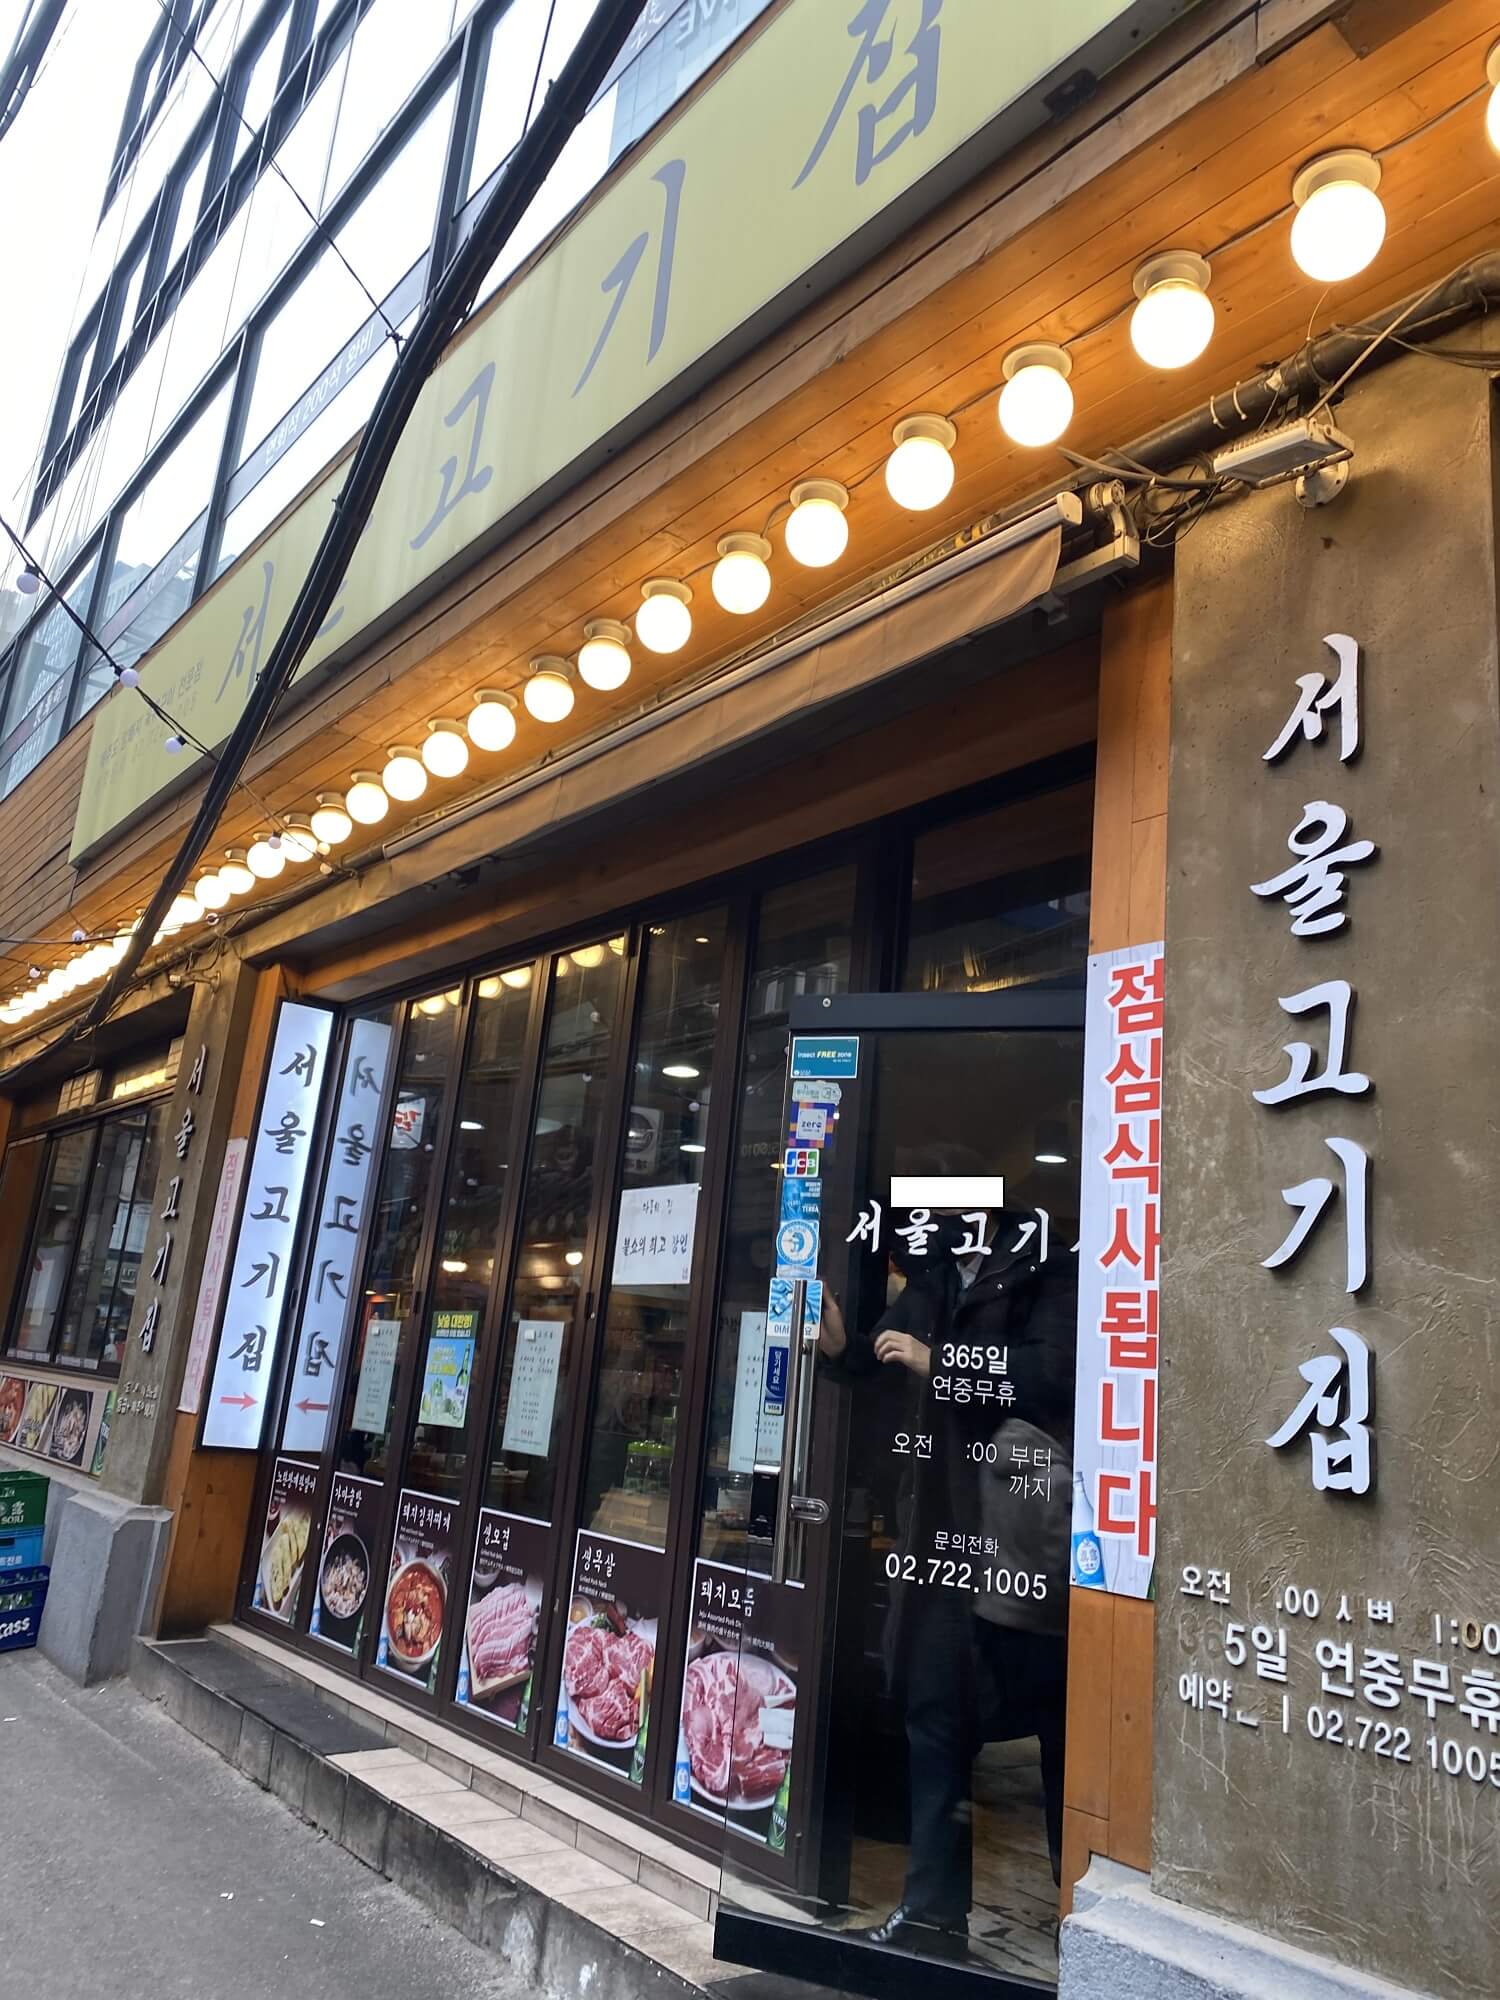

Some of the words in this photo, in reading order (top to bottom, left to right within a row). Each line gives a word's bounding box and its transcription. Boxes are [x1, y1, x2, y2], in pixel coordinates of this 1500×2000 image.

[816, 1050, 837, 1058] FREE
[1249, 633, 1379, 1495] 서울고기집
[785, 1157, 817, 1169] JCB
[138, 1044, 206, 1355] 서울고기집
[228, 1044, 317, 1373] 서울고기집
[846, 1199, 1080, 1263] 서울고기
[1099, 957, 1164, 1557] 점심식사됩니다
[941, 1343, 1009, 1375] 365일
[932, 1374, 1018, 1408] 연중무휴
[891, 1432, 933, 1459] 오전
[965, 1441, 998, 1463] :00
[1009, 1444, 1052, 1473] 부터
[1008, 1474, 1052, 1503] 까지
[402, 1501, 452, 1533] 돼지김치찌개
[581, 1545, 616, 1578] 생목살
[934, 1530, 999, 1558] 문의전화
[885, 1552, 1047, 1600] 02.722.1005
[1180, 1566, 1231, 1605] 오전
[700, 1577, 755, 1617] 돼지모듬
[1314, 1639, 1500, 1735] 연중무휴
